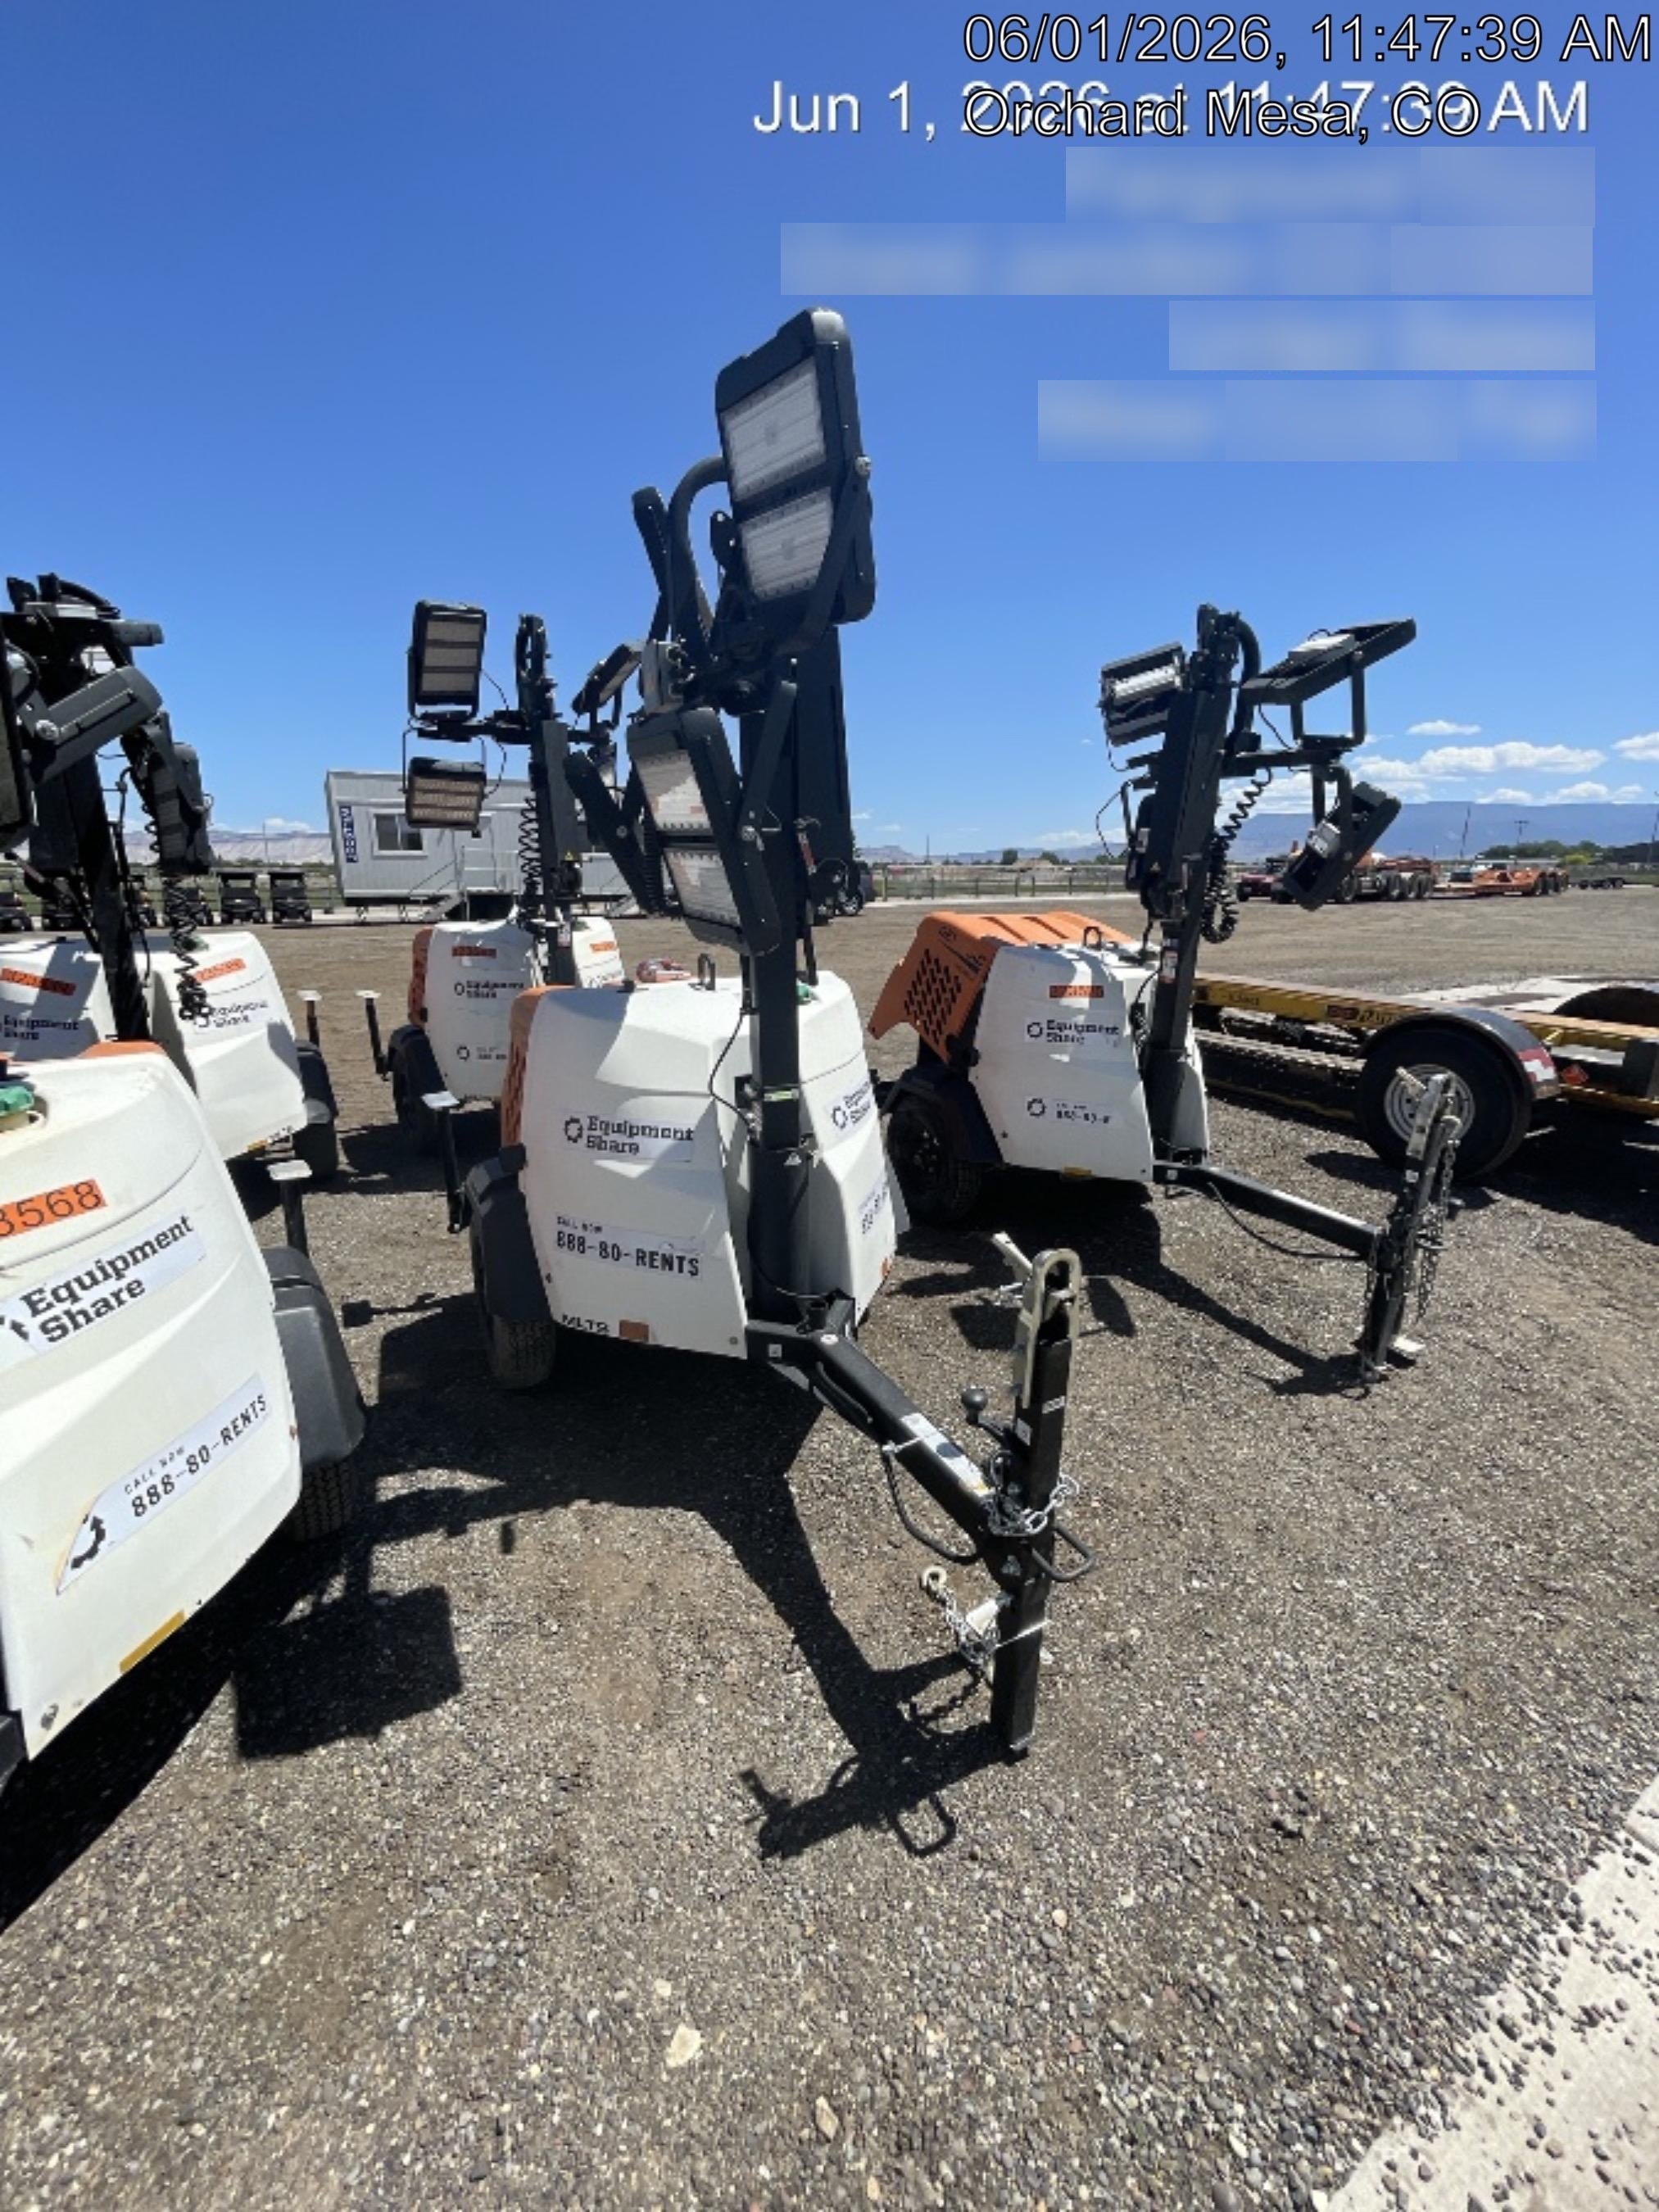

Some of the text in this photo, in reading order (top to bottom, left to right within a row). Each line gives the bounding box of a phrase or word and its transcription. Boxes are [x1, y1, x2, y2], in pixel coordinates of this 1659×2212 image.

[587, 1115, 695, 1140] Equipment
[20, 1213, 194, 1317] Equipment
[557, 1230, 699, 1276] 888-80-RENTS
[39, 1278, 146, 1342] Share
[131, 1394, 266, 1517] 888-80-RENTS
